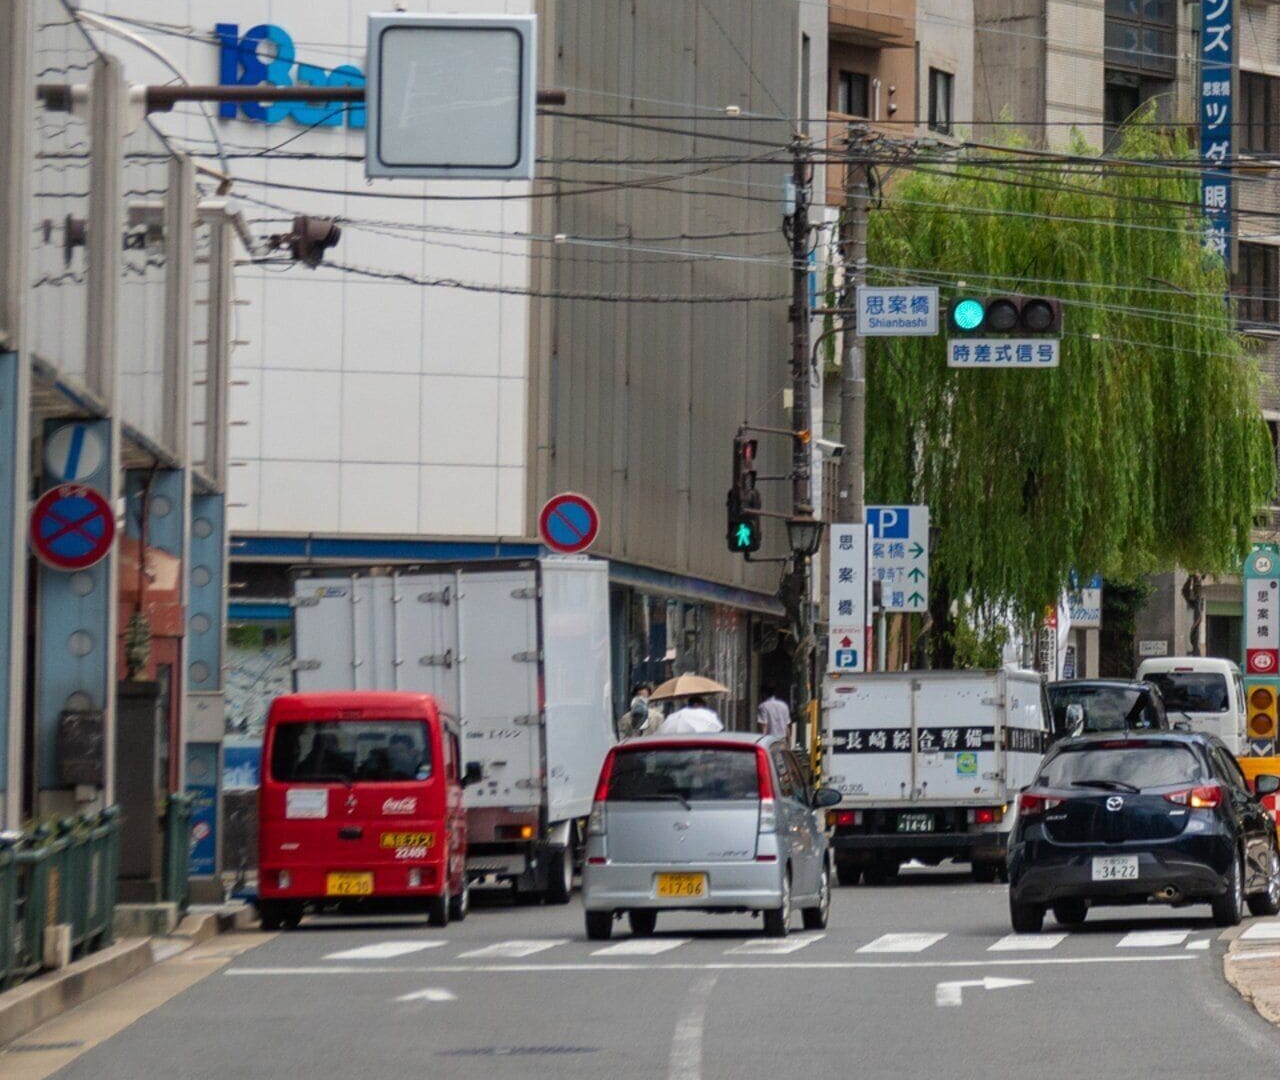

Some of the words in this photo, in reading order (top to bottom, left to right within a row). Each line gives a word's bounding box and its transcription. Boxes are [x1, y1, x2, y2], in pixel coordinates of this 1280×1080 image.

[866, 295, 929, 315] 思案橋
[868, 318, 928, 329] Shianbashi
[953, 344, 1055, 363] 時差式信号
[879, 509, 898, 538] P
[872, 542, 905, 559] 案橋
[838, 534, 853, 616] 思案橋
[1257, 590, 1269, 637] 思案橋
[840, 654, 853, 667] P
[845, 728, 984, 752] 長崎綜合警備
[1102, 865, 1136, 879] 34-22
[668, 881, 702, 894] 17-06
